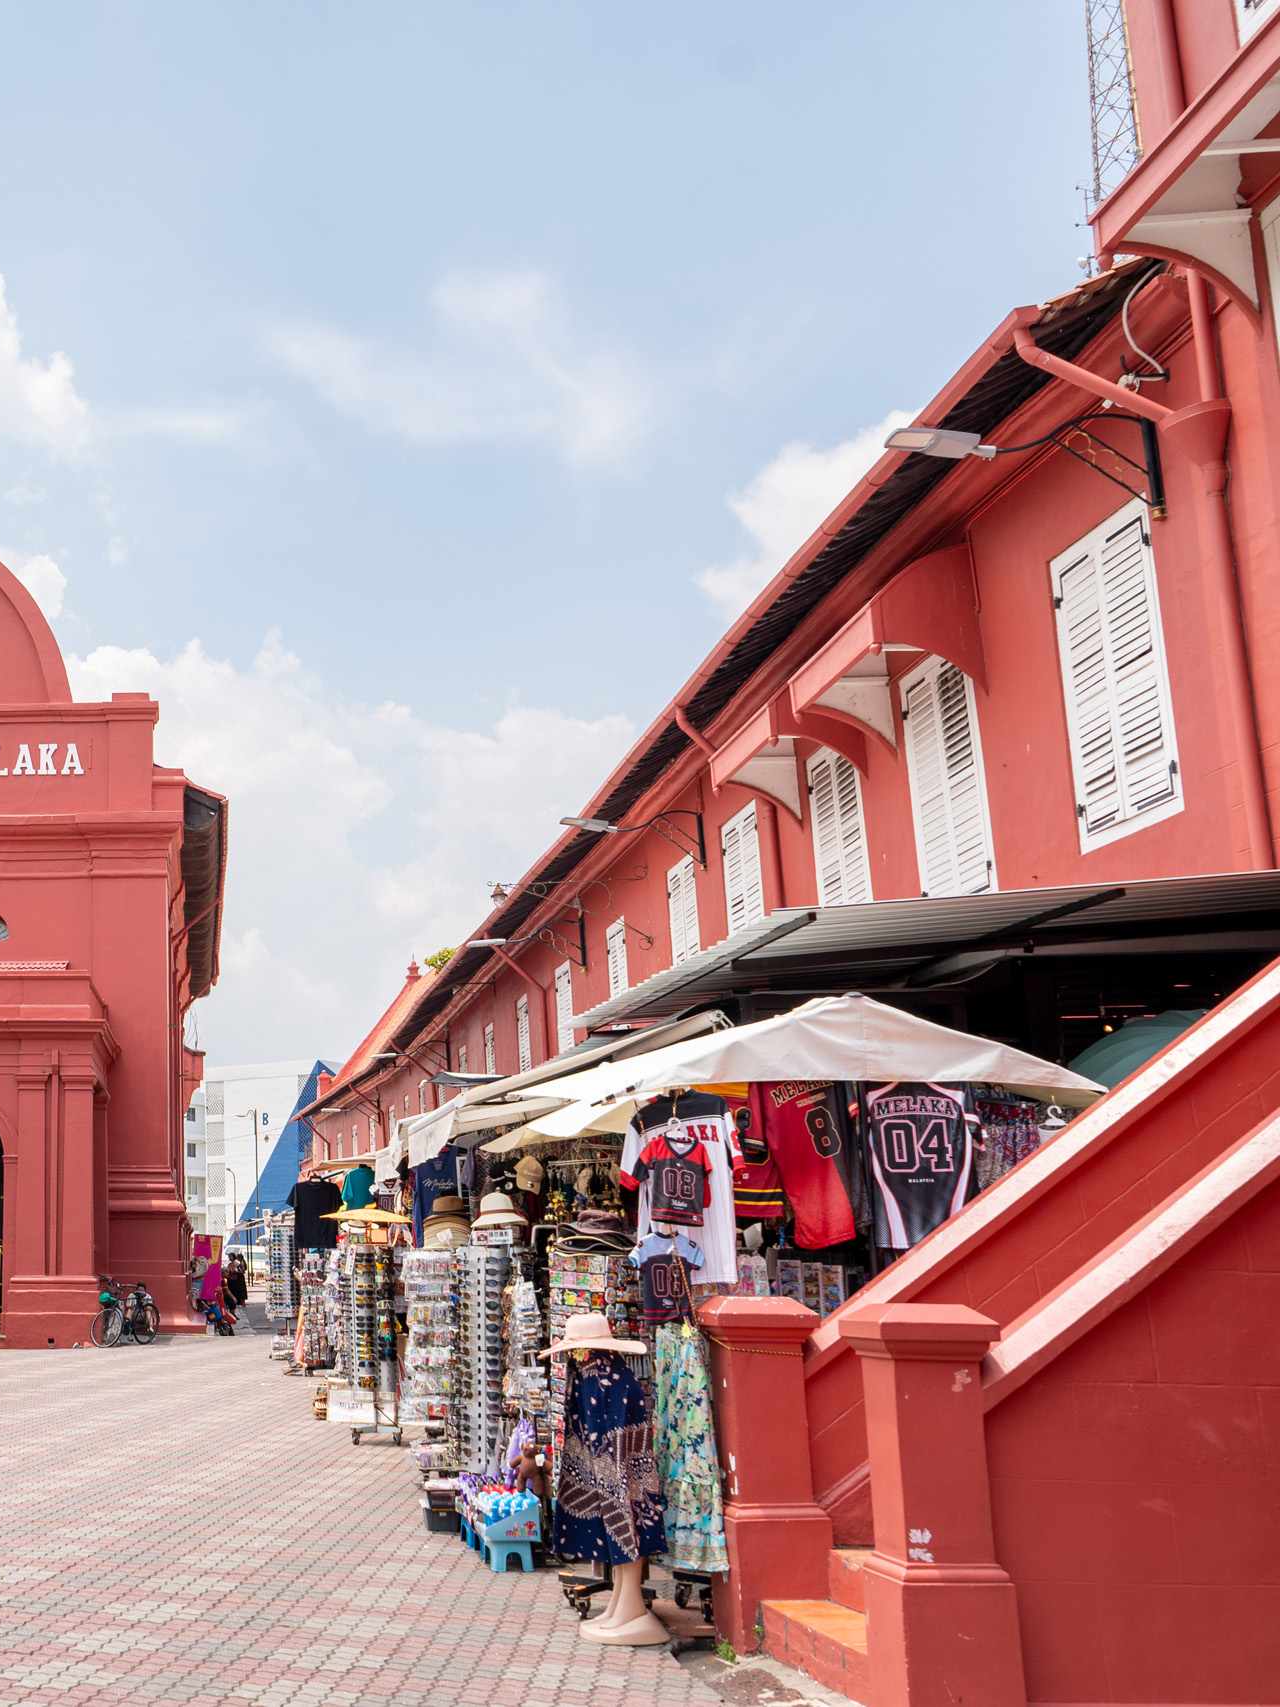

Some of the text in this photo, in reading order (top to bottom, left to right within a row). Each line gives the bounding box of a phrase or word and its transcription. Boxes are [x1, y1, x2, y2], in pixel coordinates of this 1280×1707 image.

[263, 1112, 269, 1126] B
[874, 1096, 957, 1119] MELAKA
[805, 1106, 842, 1159] 8
[880, 1119, 954, 1172] 04
[662, 1167, 696, 1200] 08
[651, 1263, 685, 1298] 08
